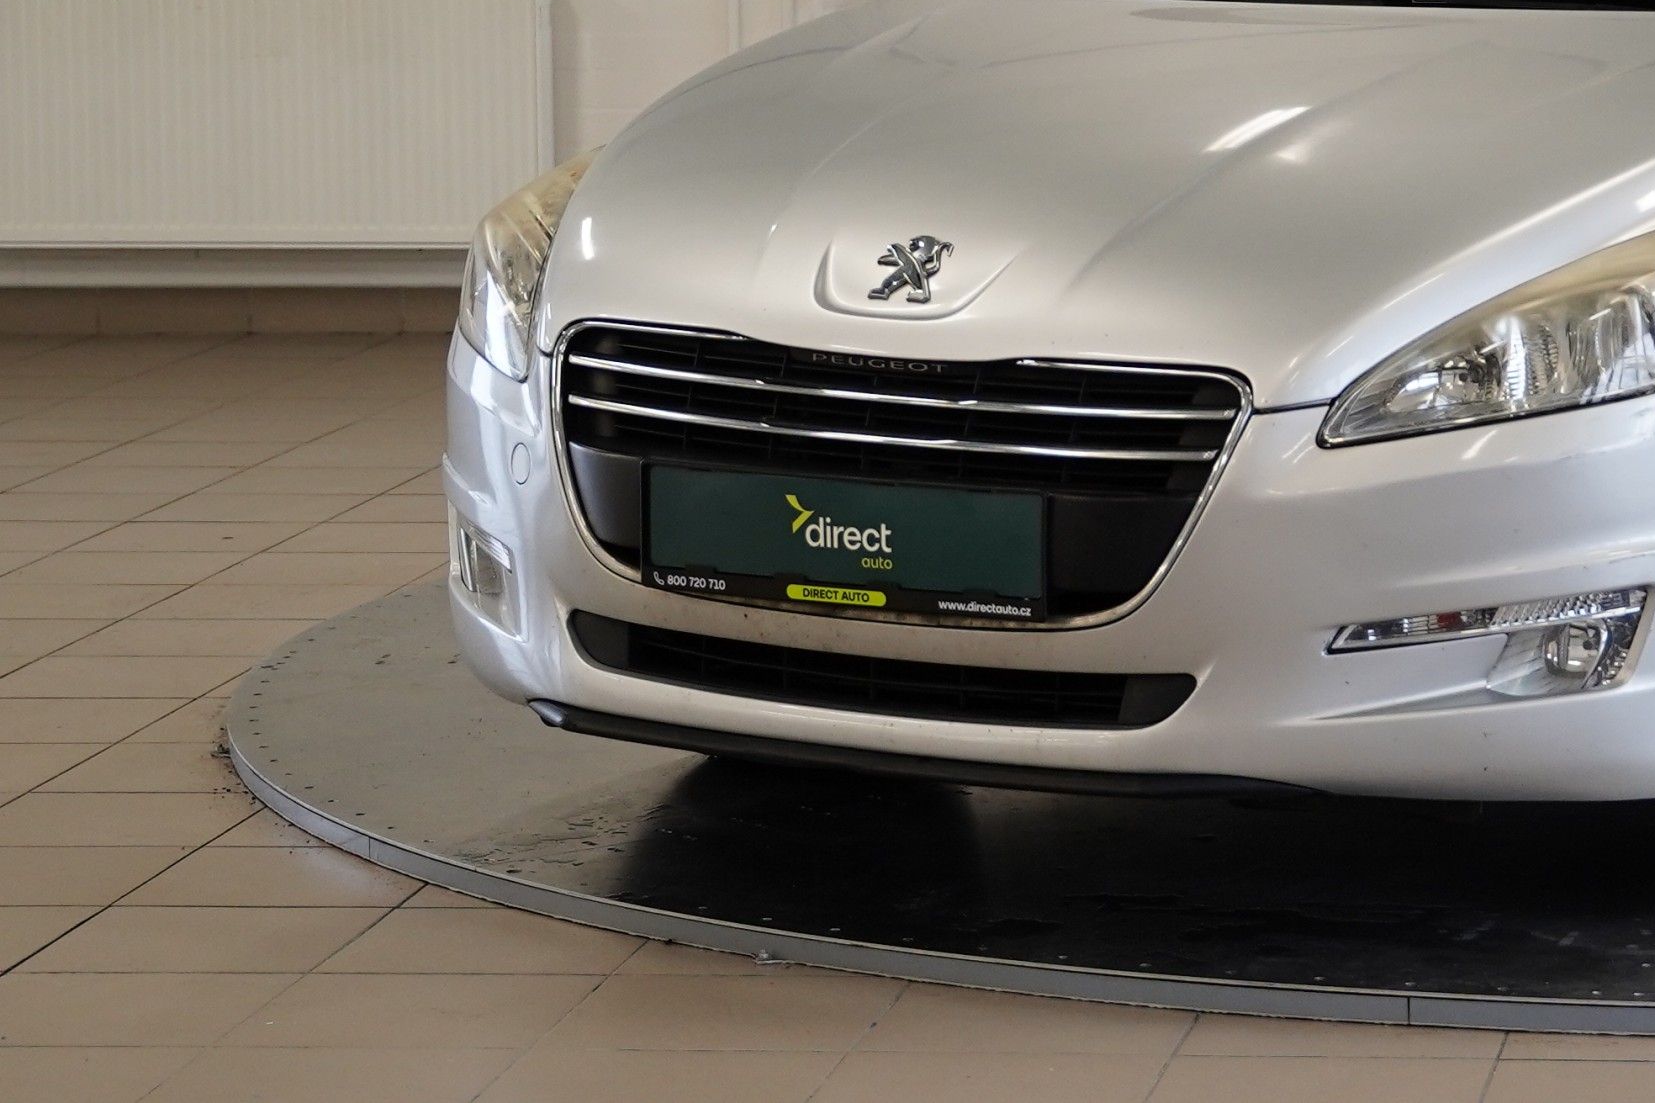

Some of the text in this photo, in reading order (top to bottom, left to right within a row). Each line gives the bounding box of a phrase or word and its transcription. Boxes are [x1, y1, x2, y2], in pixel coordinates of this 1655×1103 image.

[812, 353, 947, 373] PEUGEOT
[805, 517, 892, 553] direct
[861, 556, 892, 569] auto
[667, 575, 725, 590] 800 720 710
[802, 587, 870, 603] DIRECT AUTO
[938, 599, 1031, 616] www.directauto.cz
